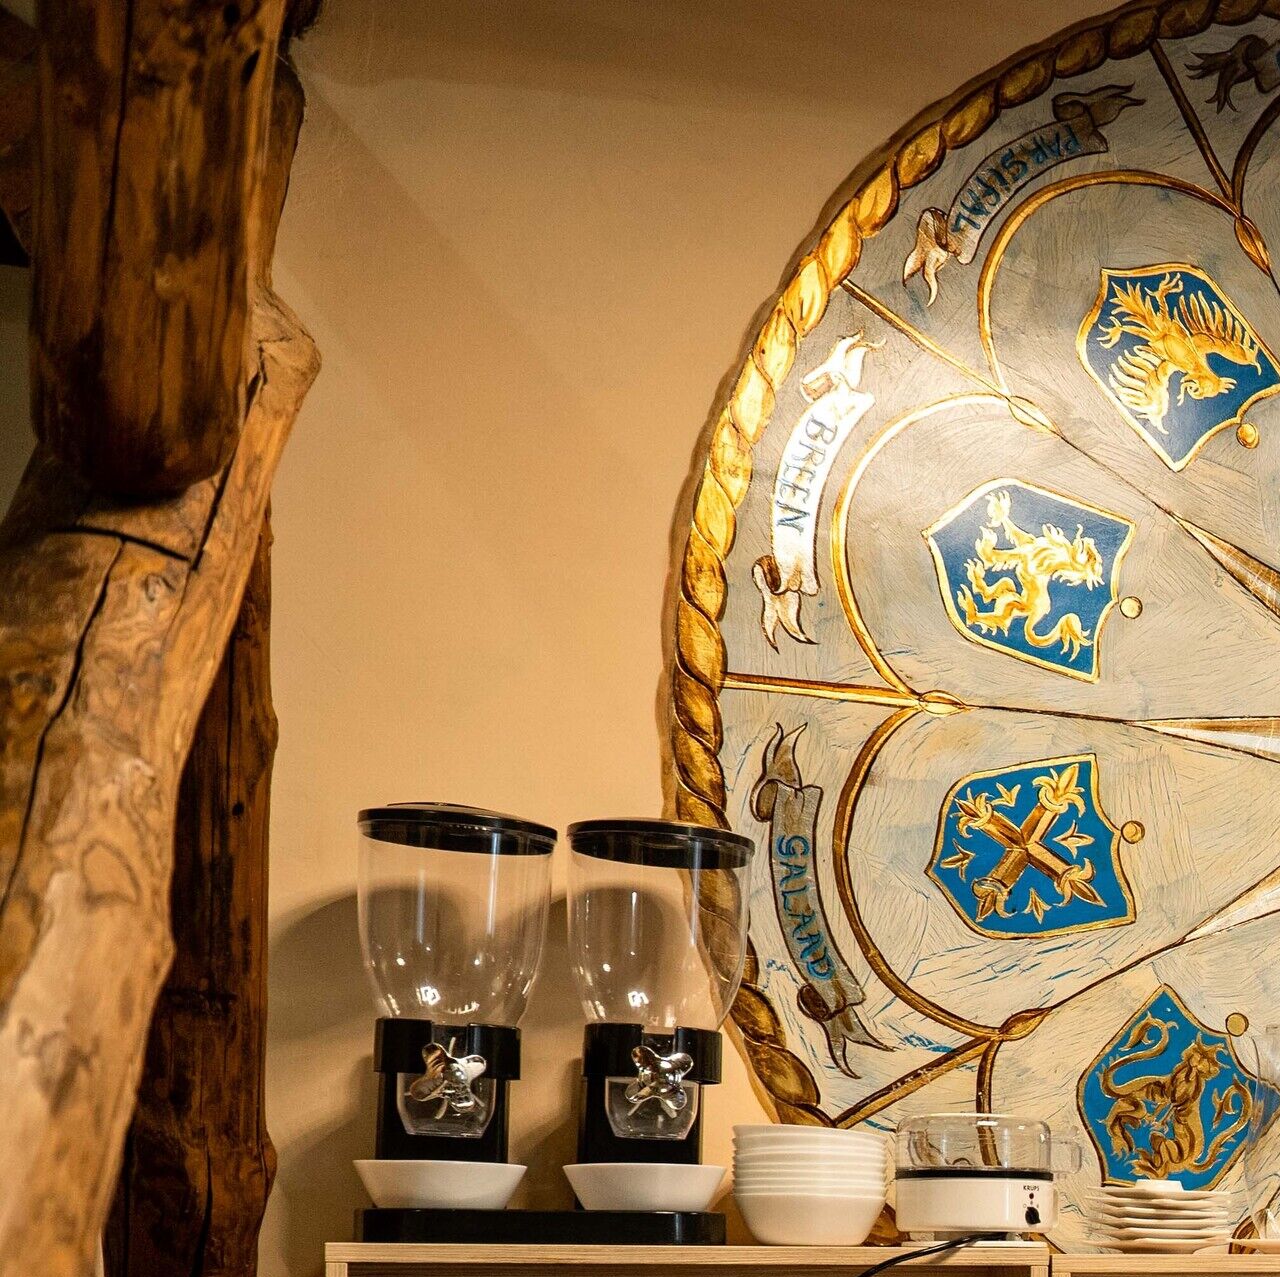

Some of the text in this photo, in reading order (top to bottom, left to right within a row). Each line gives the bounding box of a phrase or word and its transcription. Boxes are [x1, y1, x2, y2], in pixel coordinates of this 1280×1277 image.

[950, 121, 1083, 237] PARSIFAL
[775, 415, 838, 535] BREEN
[775, 834, 834, 981] GALAAD
